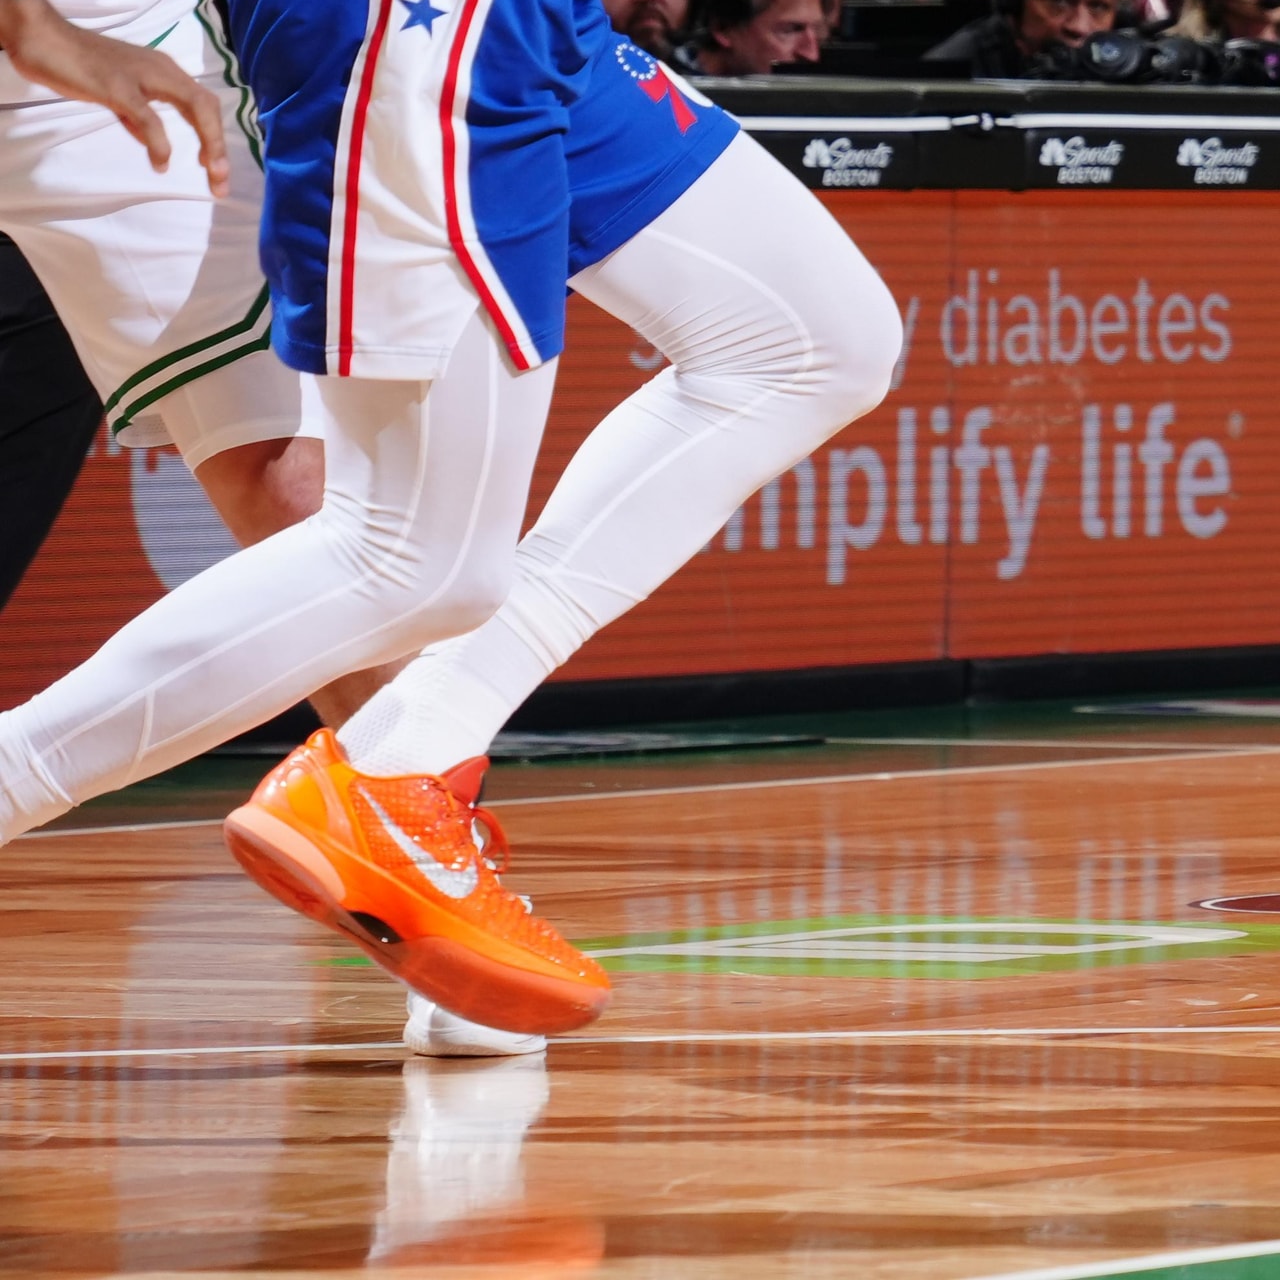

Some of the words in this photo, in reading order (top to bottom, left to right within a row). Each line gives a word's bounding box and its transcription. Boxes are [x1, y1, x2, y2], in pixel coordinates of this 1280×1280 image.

[941, 269, 1233, 366] diabetes
[700, 404, 1049, 585] mplify
[1081, 404, 1232, 539] life
